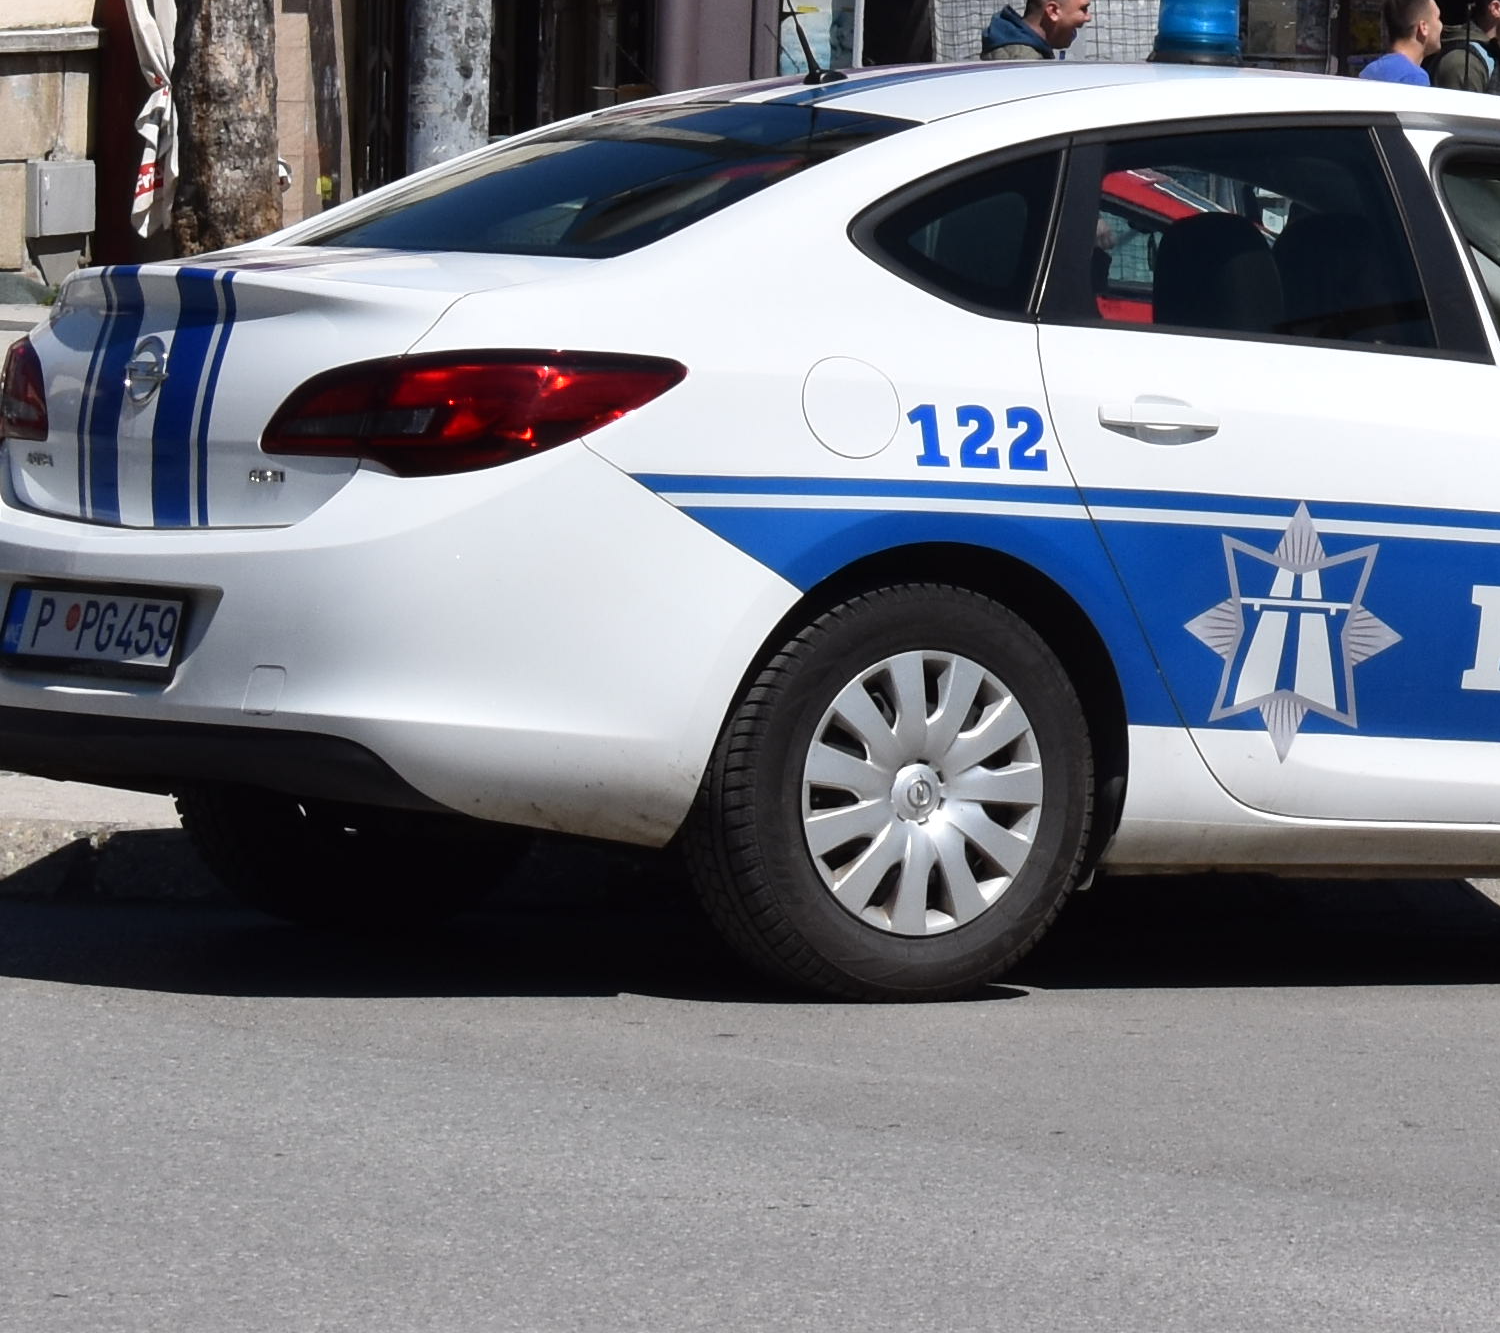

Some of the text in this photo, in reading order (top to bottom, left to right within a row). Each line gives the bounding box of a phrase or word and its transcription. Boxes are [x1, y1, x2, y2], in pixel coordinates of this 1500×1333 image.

[907, 403, 1048, 472] 122
[31, 597, 179, 658] P PG459
